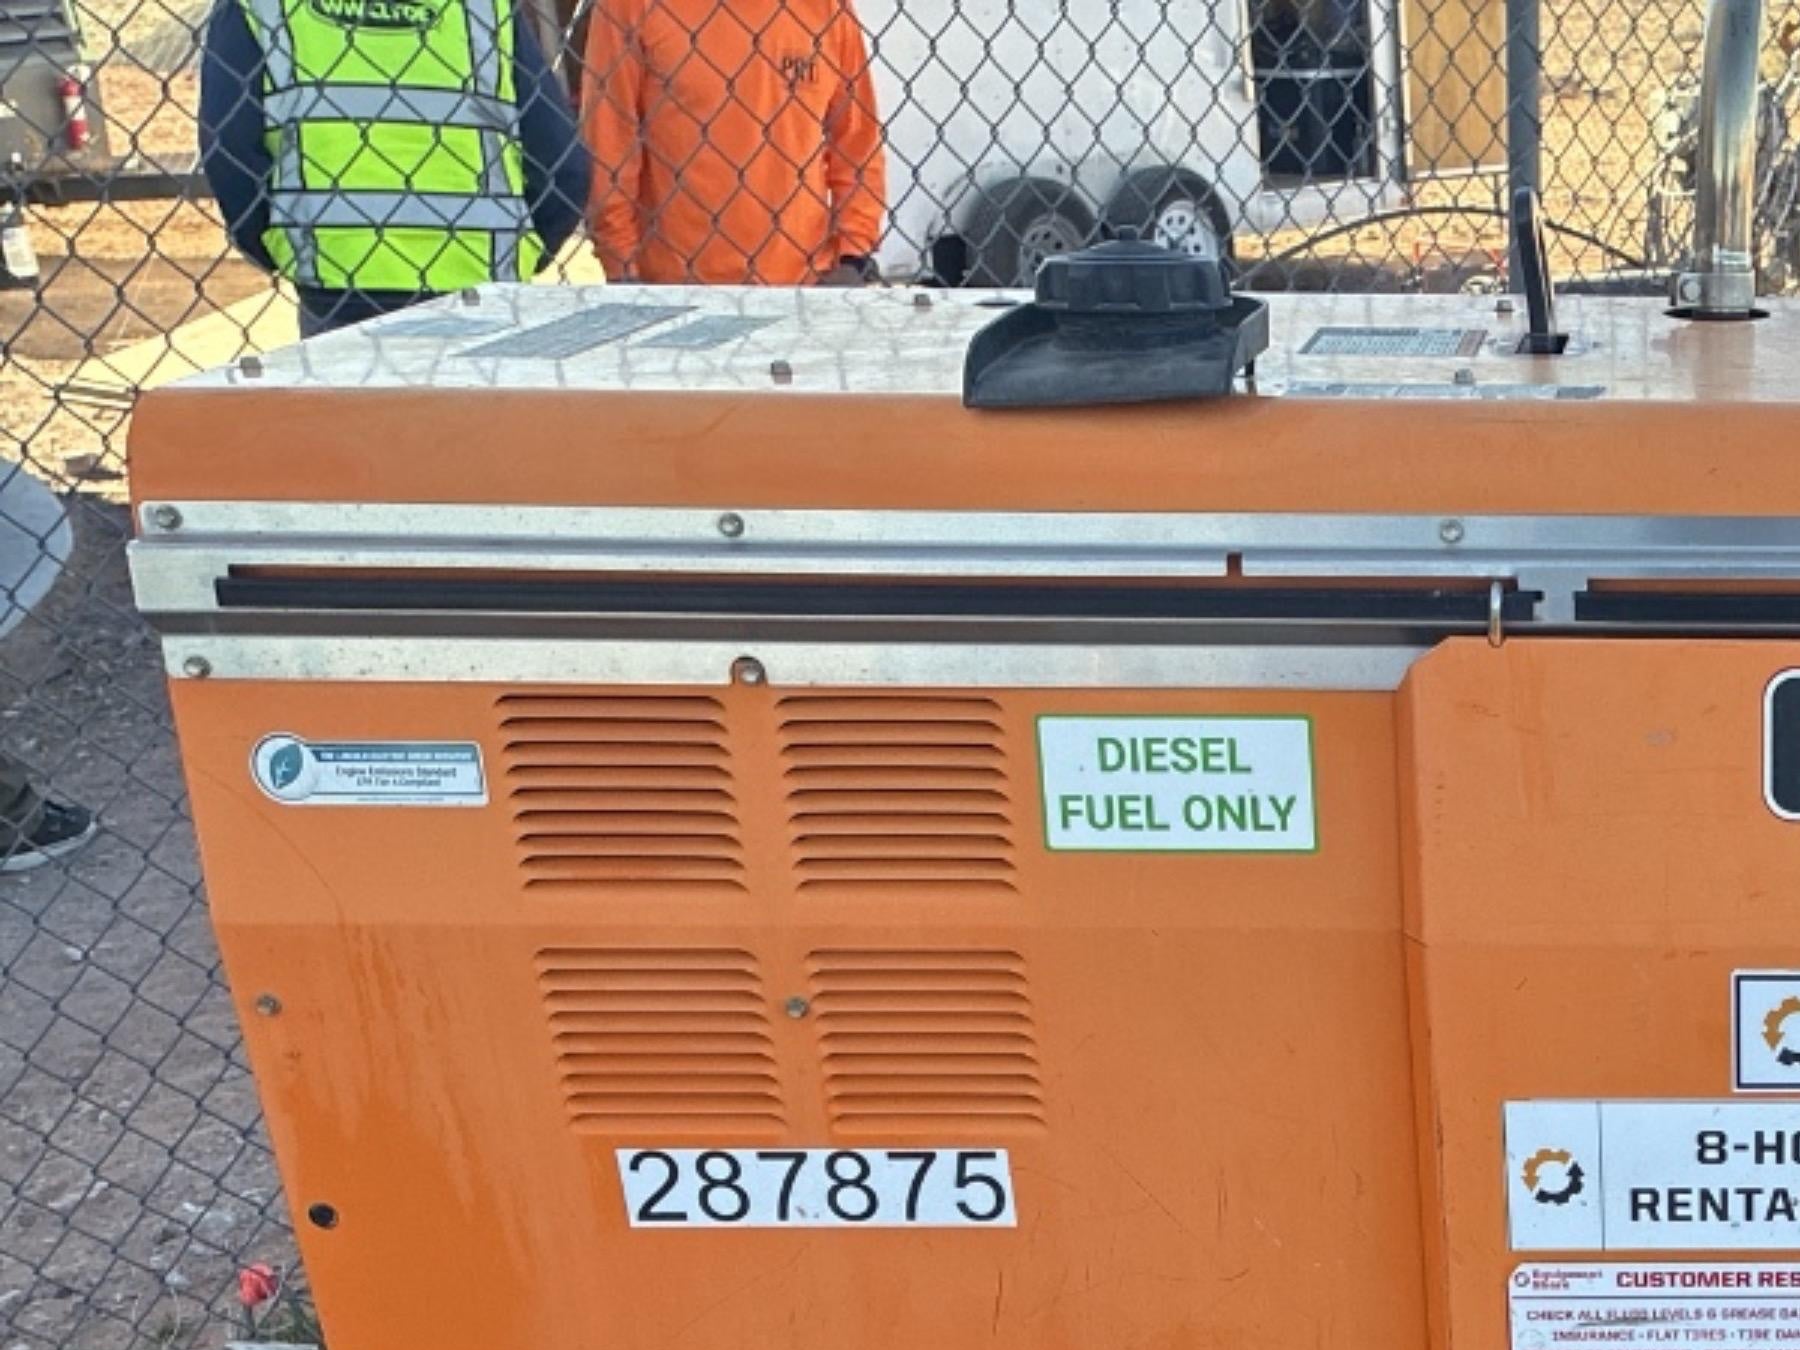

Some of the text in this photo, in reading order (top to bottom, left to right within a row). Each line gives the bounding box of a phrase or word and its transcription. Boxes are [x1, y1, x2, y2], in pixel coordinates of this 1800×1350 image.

[1097, 737, 1253, 773] DIESEL
[1059, 794, 1297, 832] FUEL ONLY
[628, 1150, 1007, 1222] 287875
[1616, 1271, 1751, 1288] CUSTOMER
[1526, 1310, 1573, 1321] CHECK
[1577, 1309, 1602, 1321] ALL
[1652, 1308, 1704, 1321] LEVELS
[1721, 1307, 1776, 1320] GREASE
[1552, 1330, 1636, 1342] INSURANCE
[1646, 1329, 1680, 1341] FLAT
[1684, 1328, 1726, 1341] TIRES
[1737, 1328, 1771, 1341] TIRE
